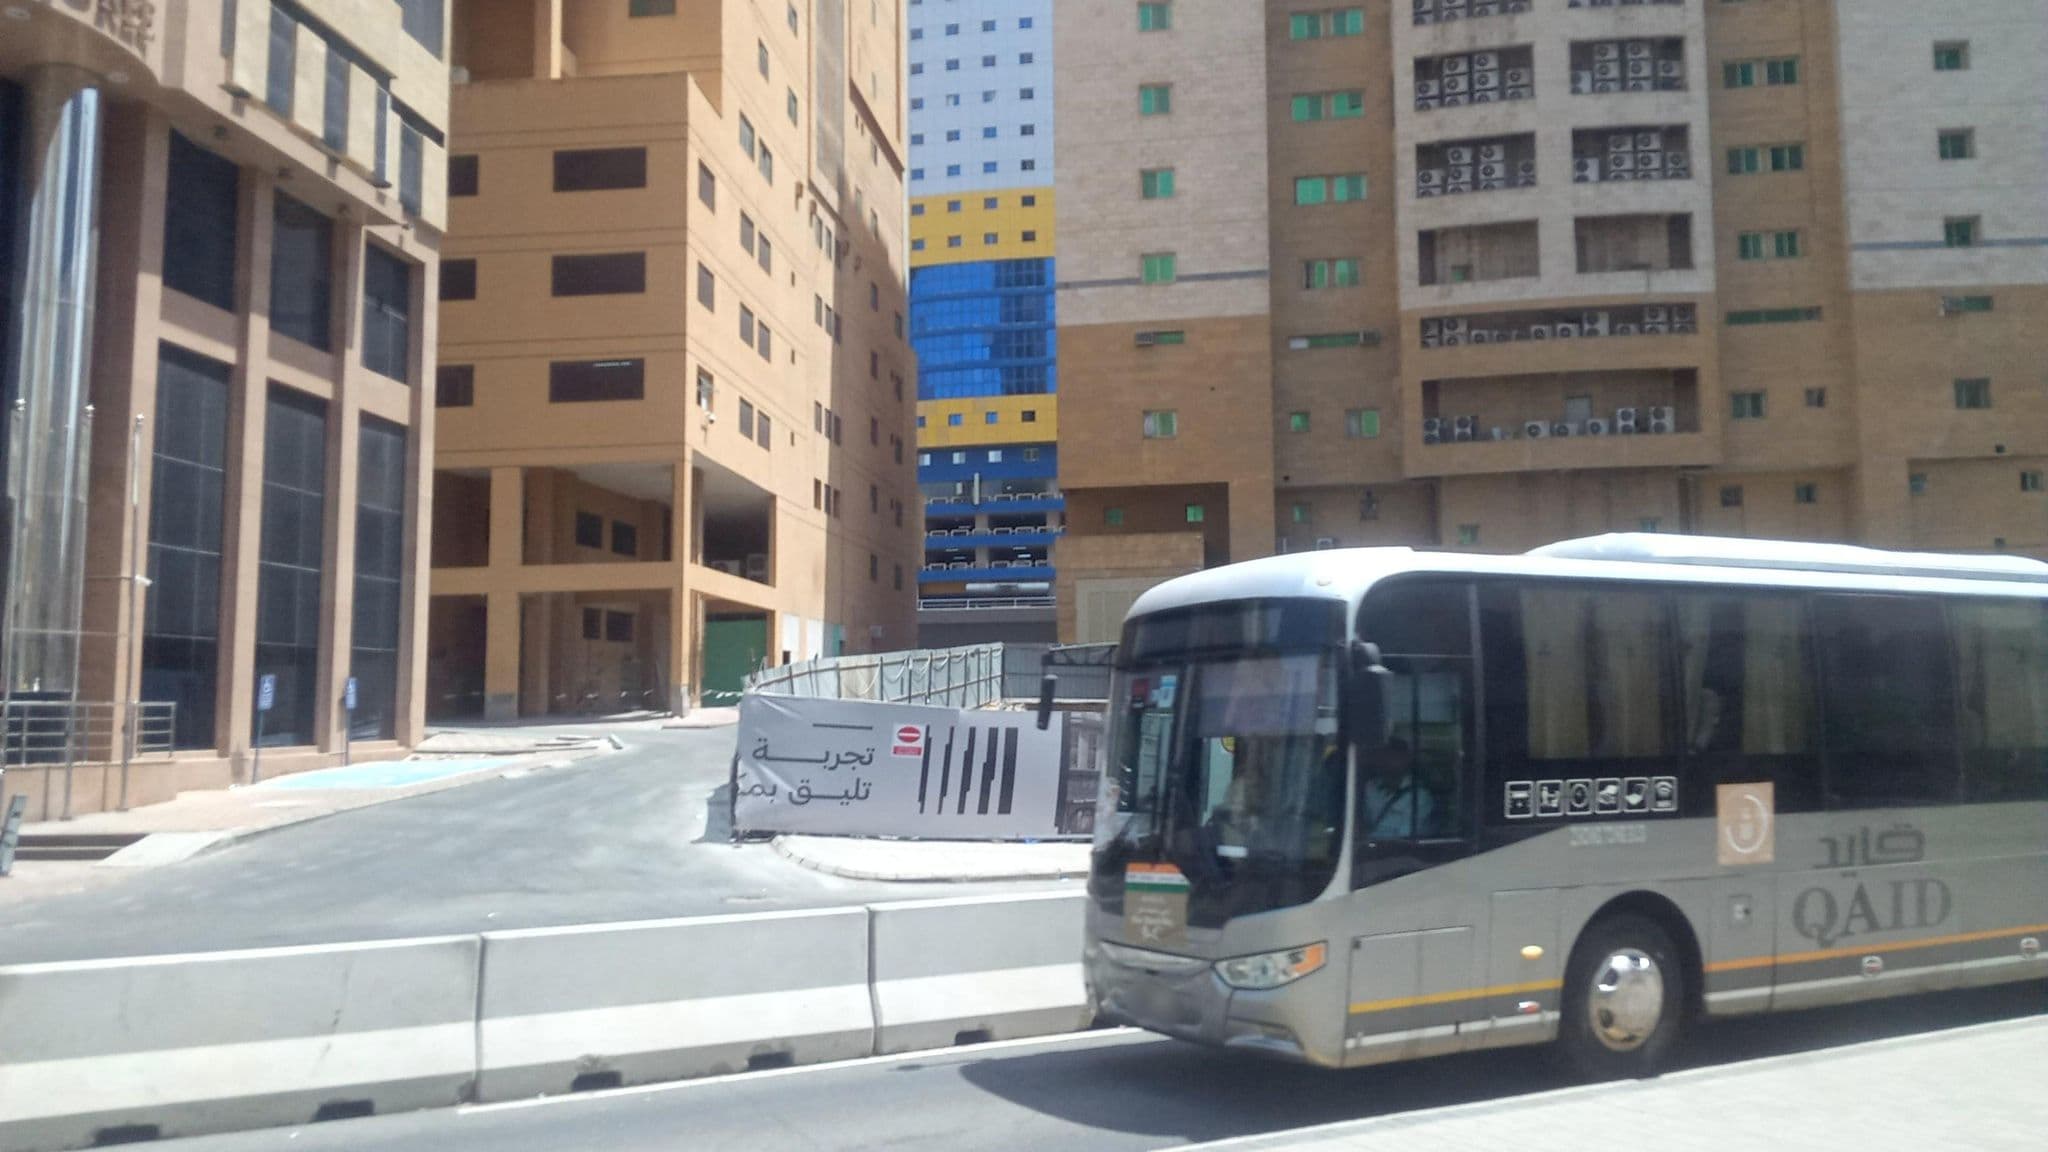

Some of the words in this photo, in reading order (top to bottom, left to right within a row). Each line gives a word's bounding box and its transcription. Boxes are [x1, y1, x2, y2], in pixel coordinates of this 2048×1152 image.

[752, 737, 875, 771] تجربة
[788, 777, 872, 806] تليق
[1791, 878, 1953, 948] QAID
